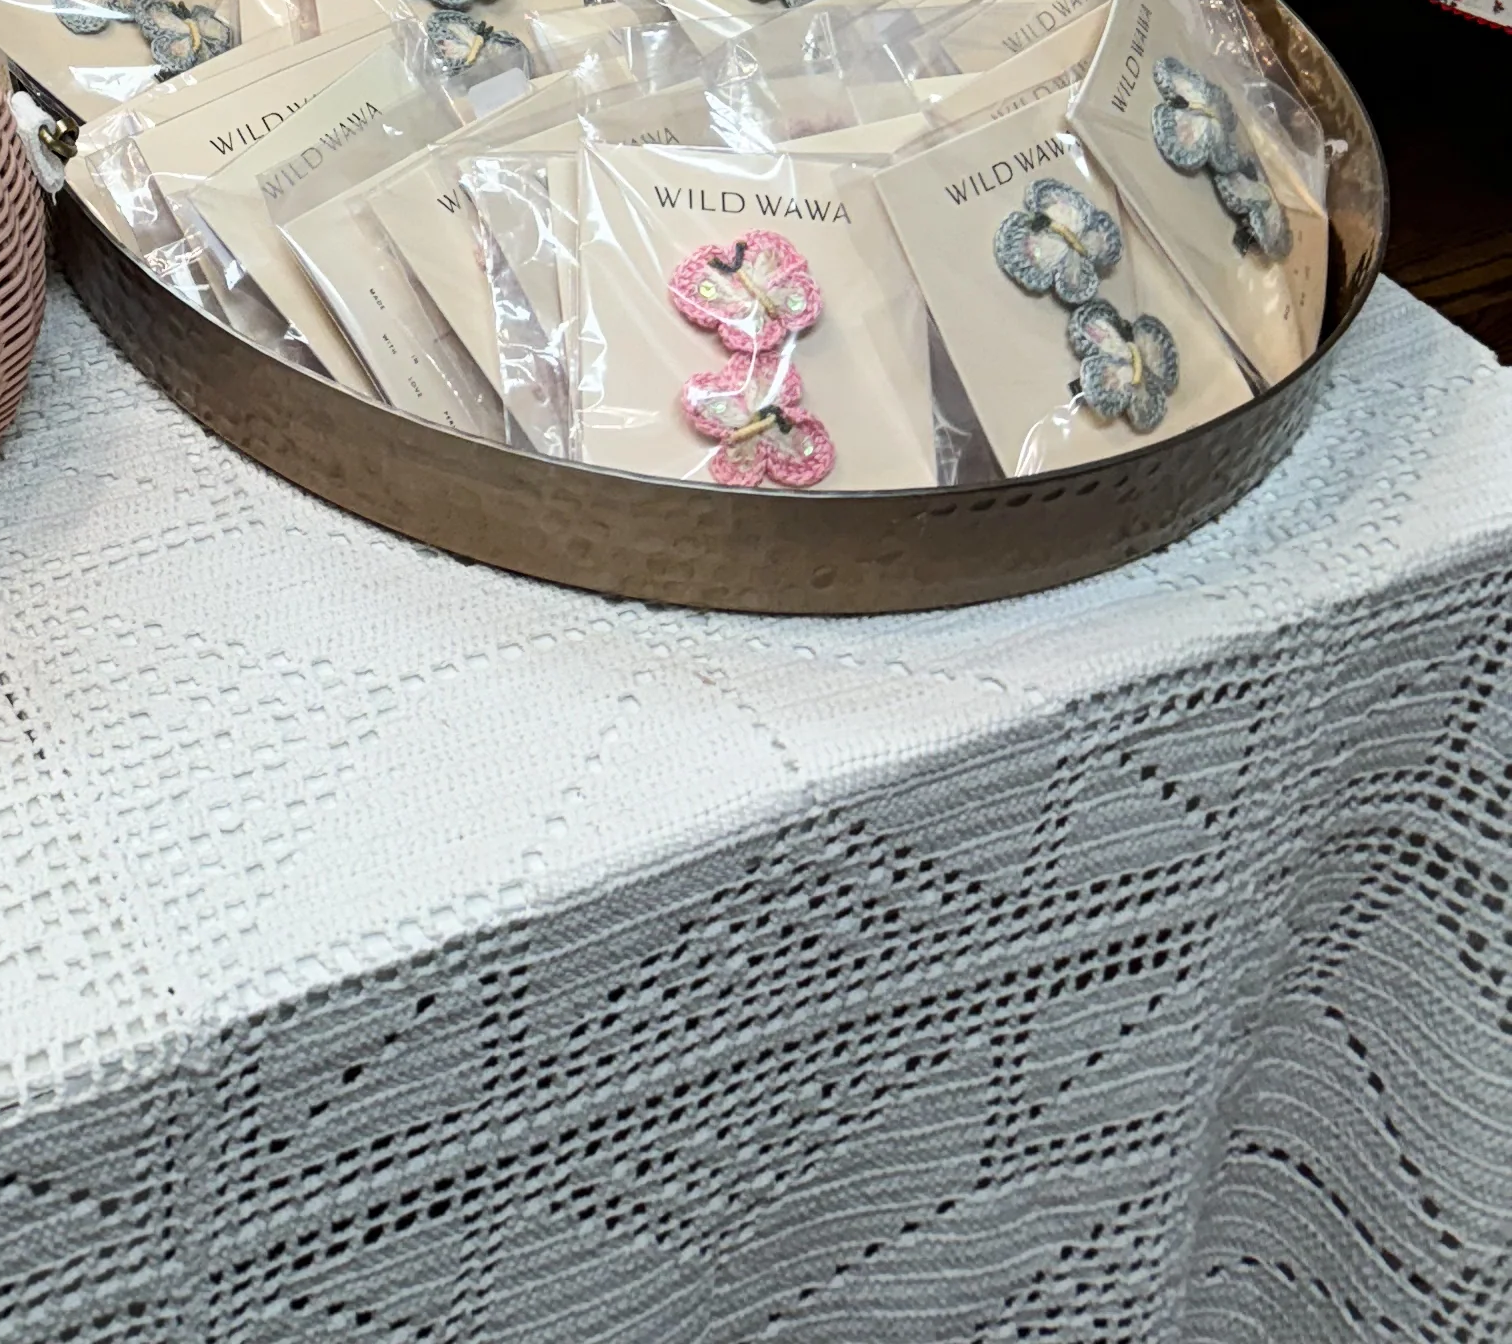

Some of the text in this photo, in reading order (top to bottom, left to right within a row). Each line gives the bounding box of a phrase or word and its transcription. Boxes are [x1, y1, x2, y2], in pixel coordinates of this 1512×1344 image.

[1111, 3, 1153, 113] WILD WAWA
[209, 111, 284, 156] WILD
[262, 101, 383, 200] WILD WAWA
[654, 185, 853, 225] WILD WAWA
[944, 161, 1014, 206] WILD
